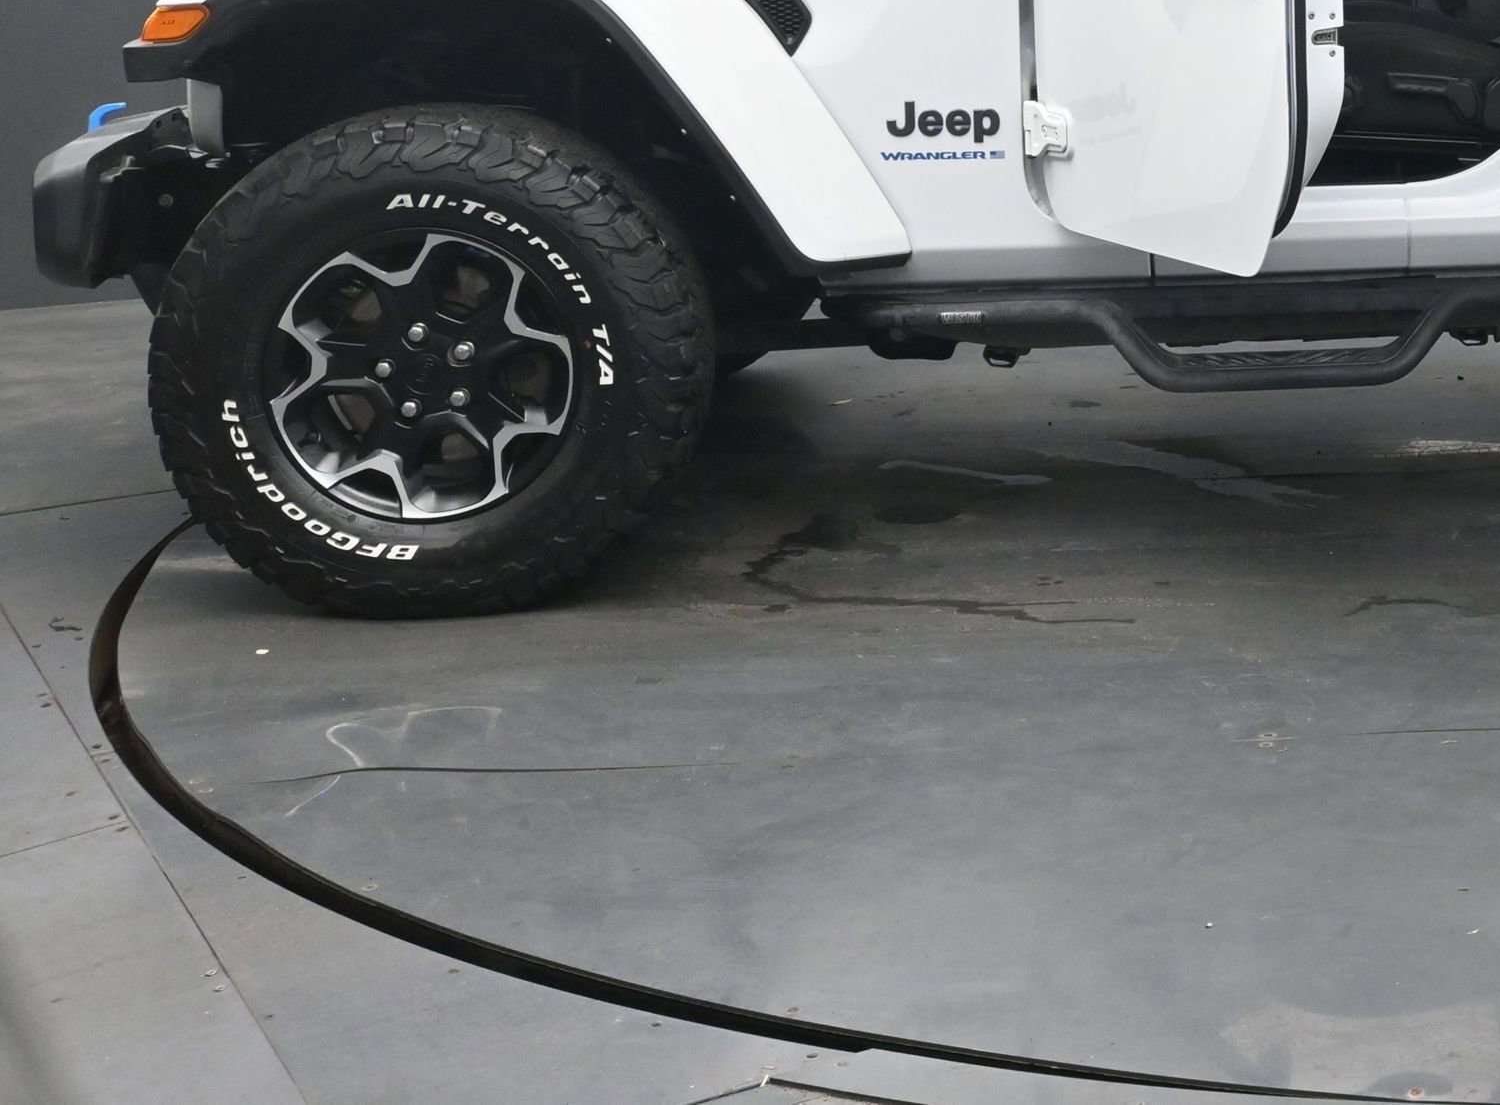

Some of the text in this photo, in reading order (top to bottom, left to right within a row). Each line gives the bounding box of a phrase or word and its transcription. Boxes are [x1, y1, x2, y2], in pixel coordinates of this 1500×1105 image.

[880, 150, 987, 161] WRANGLER
[886, 100, 1001, 144] Jeep
[386, 194, 614, 386] All-Terrain T/A
[221, 399, 420, 561] BFGoodrich
